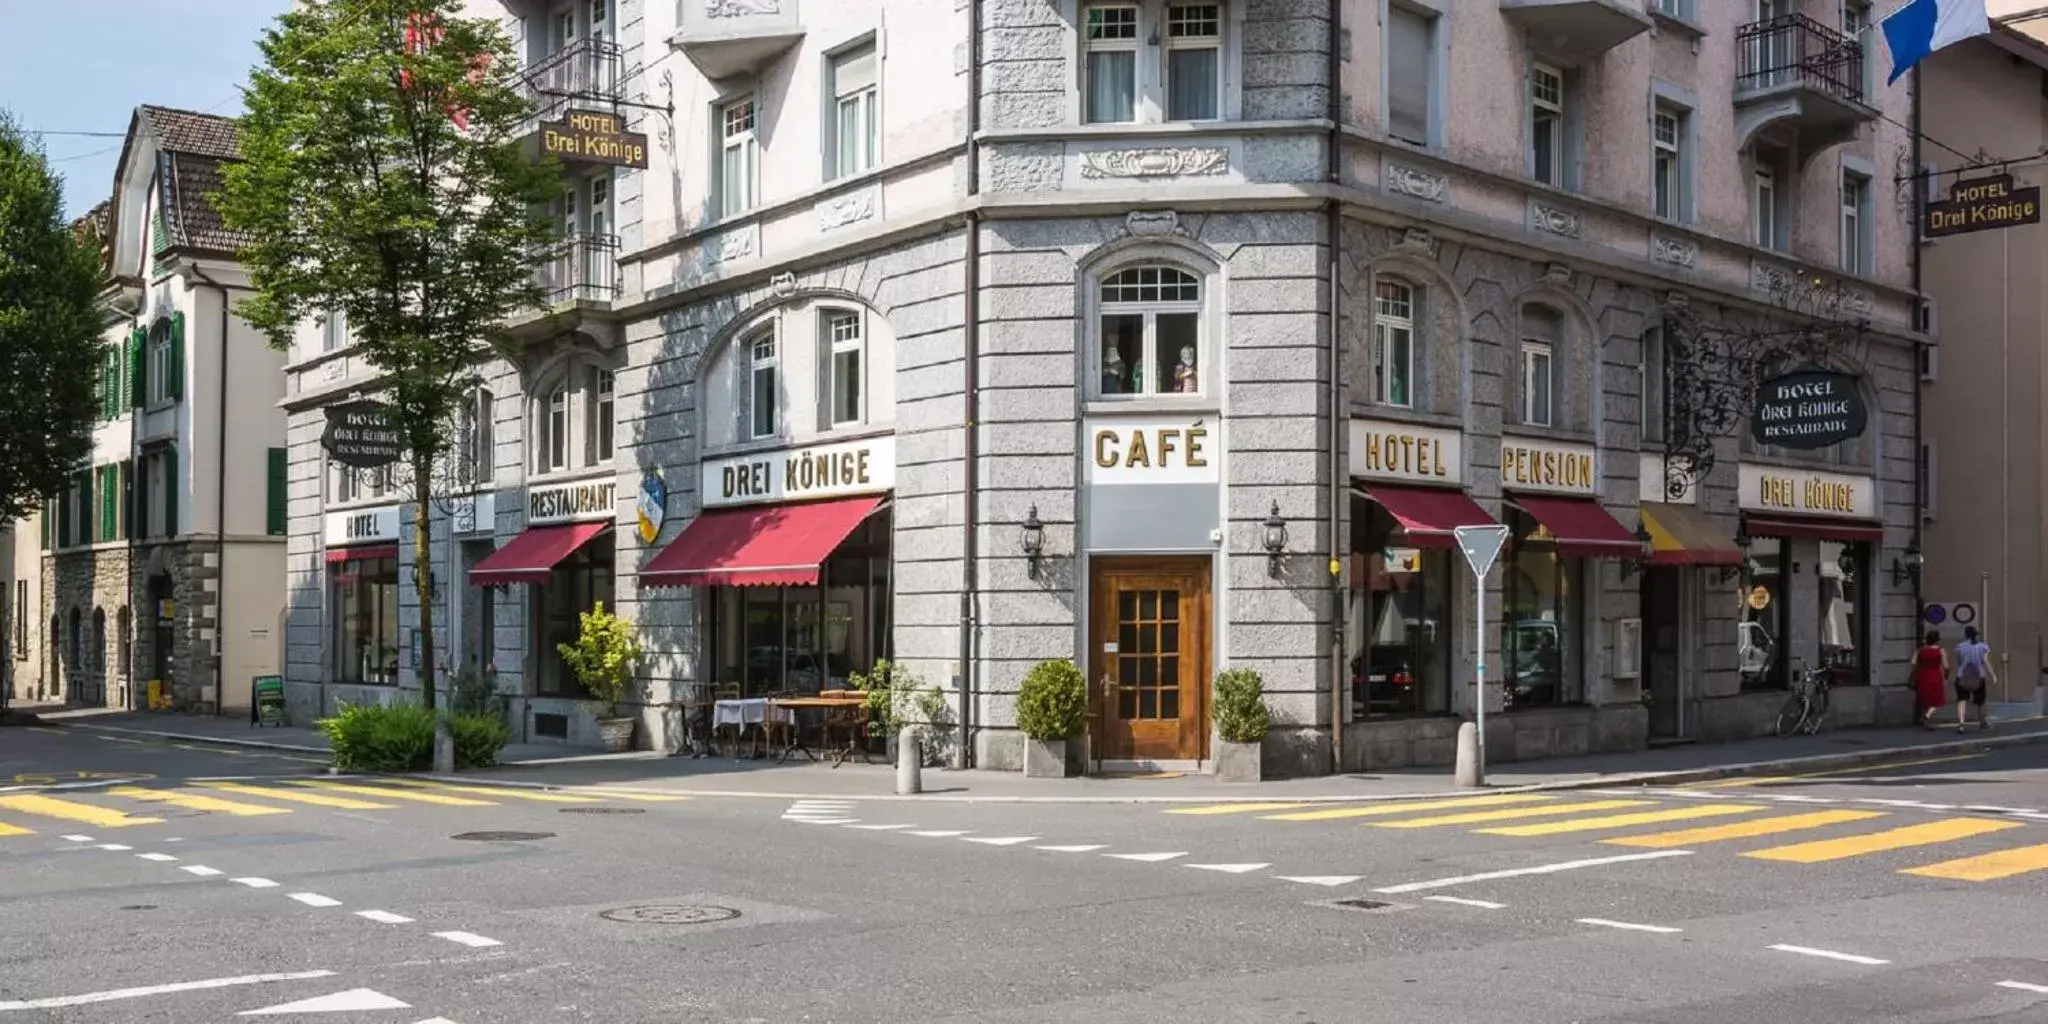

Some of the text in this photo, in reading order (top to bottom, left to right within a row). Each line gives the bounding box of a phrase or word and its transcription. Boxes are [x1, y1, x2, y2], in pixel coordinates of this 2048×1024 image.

[570, 114, 620, 134] HOTEL
[545, 130, 642, 164] Drei Könige
[1955, 183, 2008, 203] HOTEL
[1930, 200, 2034, 229] Drei Könige
[1777, 380, 1834, 400] HOTEL
[1095, 414, 1208, 468] CAFÉ
[1764, 420, 1848, 437] RESTAURANT
[1366, 432, 1446, 476] HOTEL
[1502, 447, 1592, 488] PENSION
[723, 448, 870, 498] DREI KÖNIGE
[530, 482, 616, 518] RESTAURANT
[1760, 475, 1855, 512] DREI KÖNIGE
[346, 513, 380, 539] HOTEL
